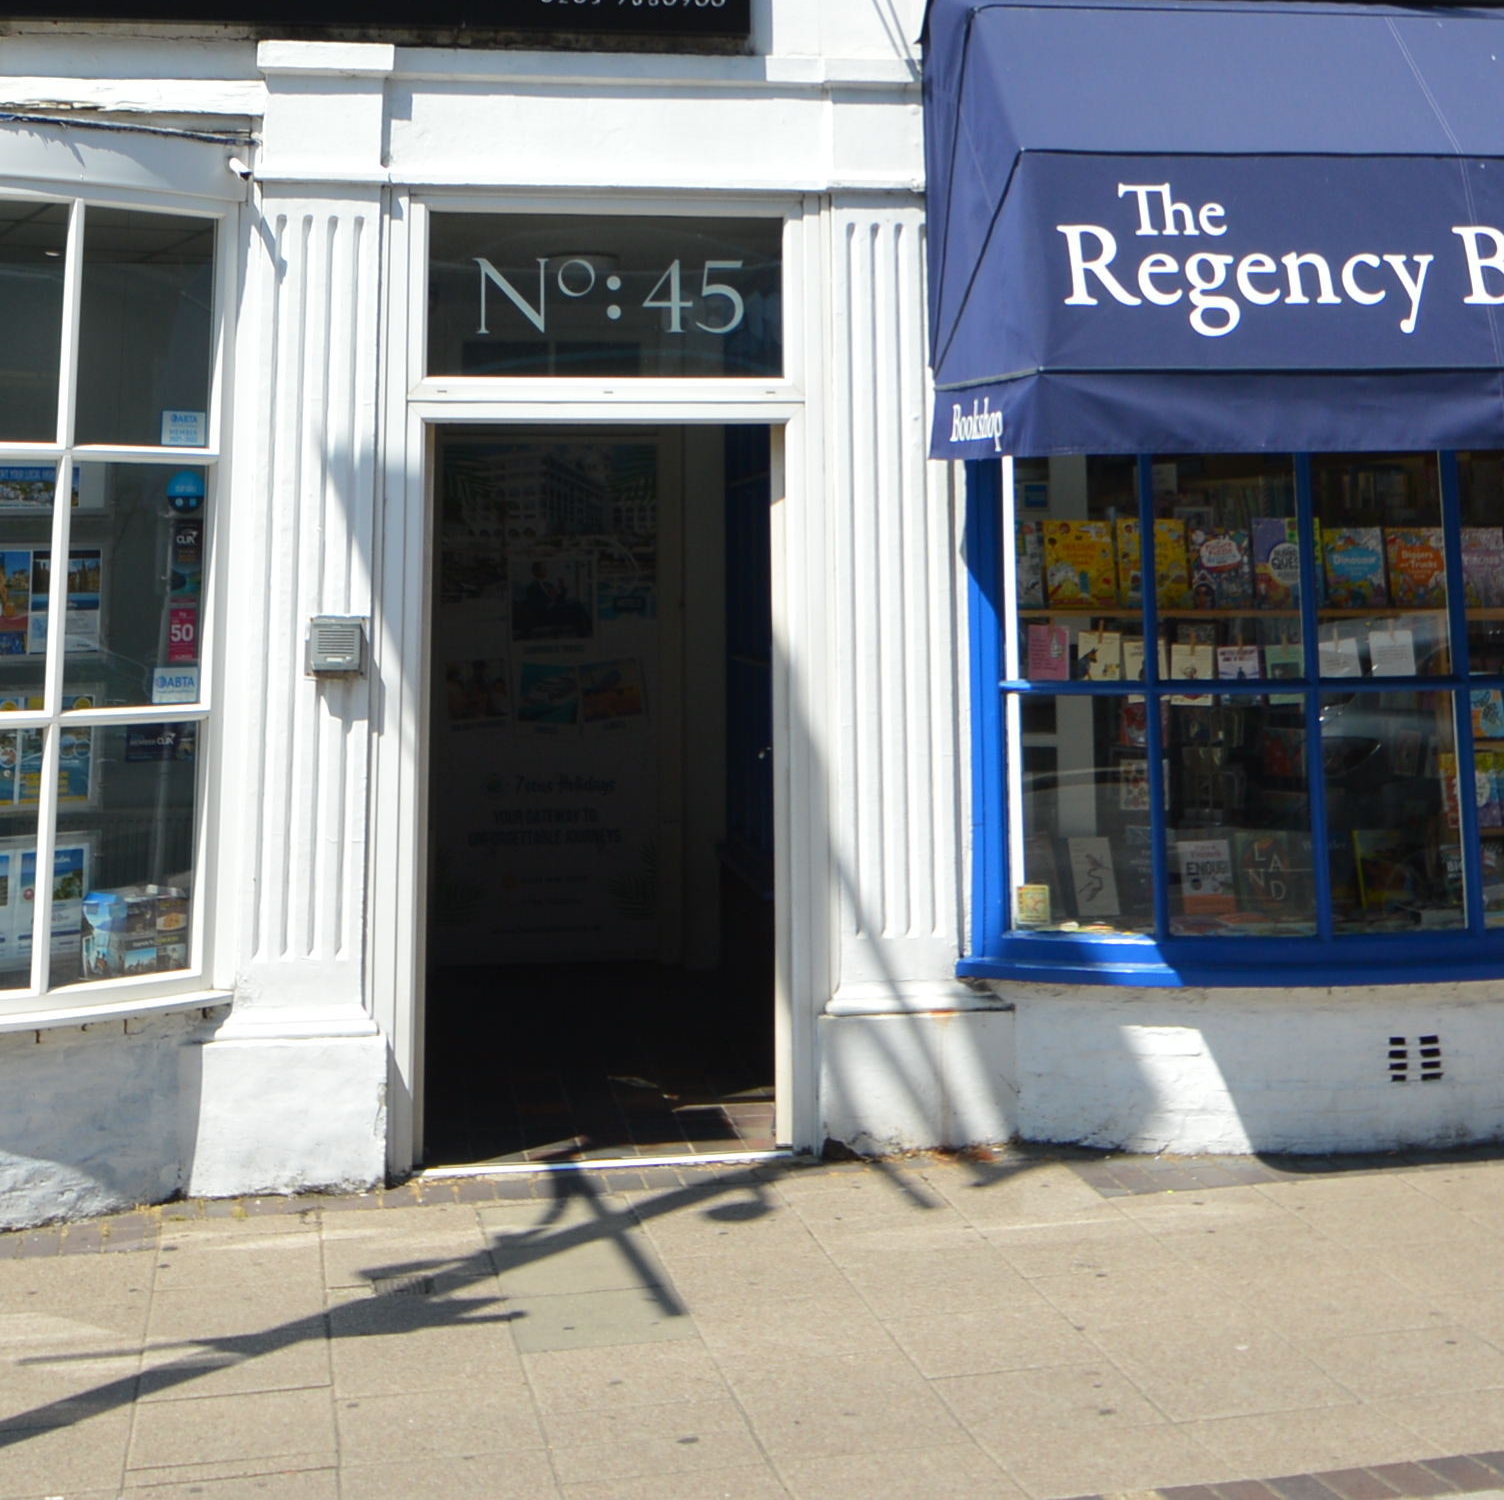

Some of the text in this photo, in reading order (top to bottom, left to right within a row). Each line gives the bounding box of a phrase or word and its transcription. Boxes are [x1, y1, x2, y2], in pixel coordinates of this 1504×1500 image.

[1117, 181, 1228, 238] The
[1056, 222, 1434, 336] Regency
[949, 396, 1004, 453] Bookshop
[1332, 554, 1377, 566] Dinosaur
[1400, 551, 1434, 561] Diggers
[1410, 560, 1438, 570] Trucks
[170, 623, 194, 642] 50
[166, 676, 196, 688] ABTA
